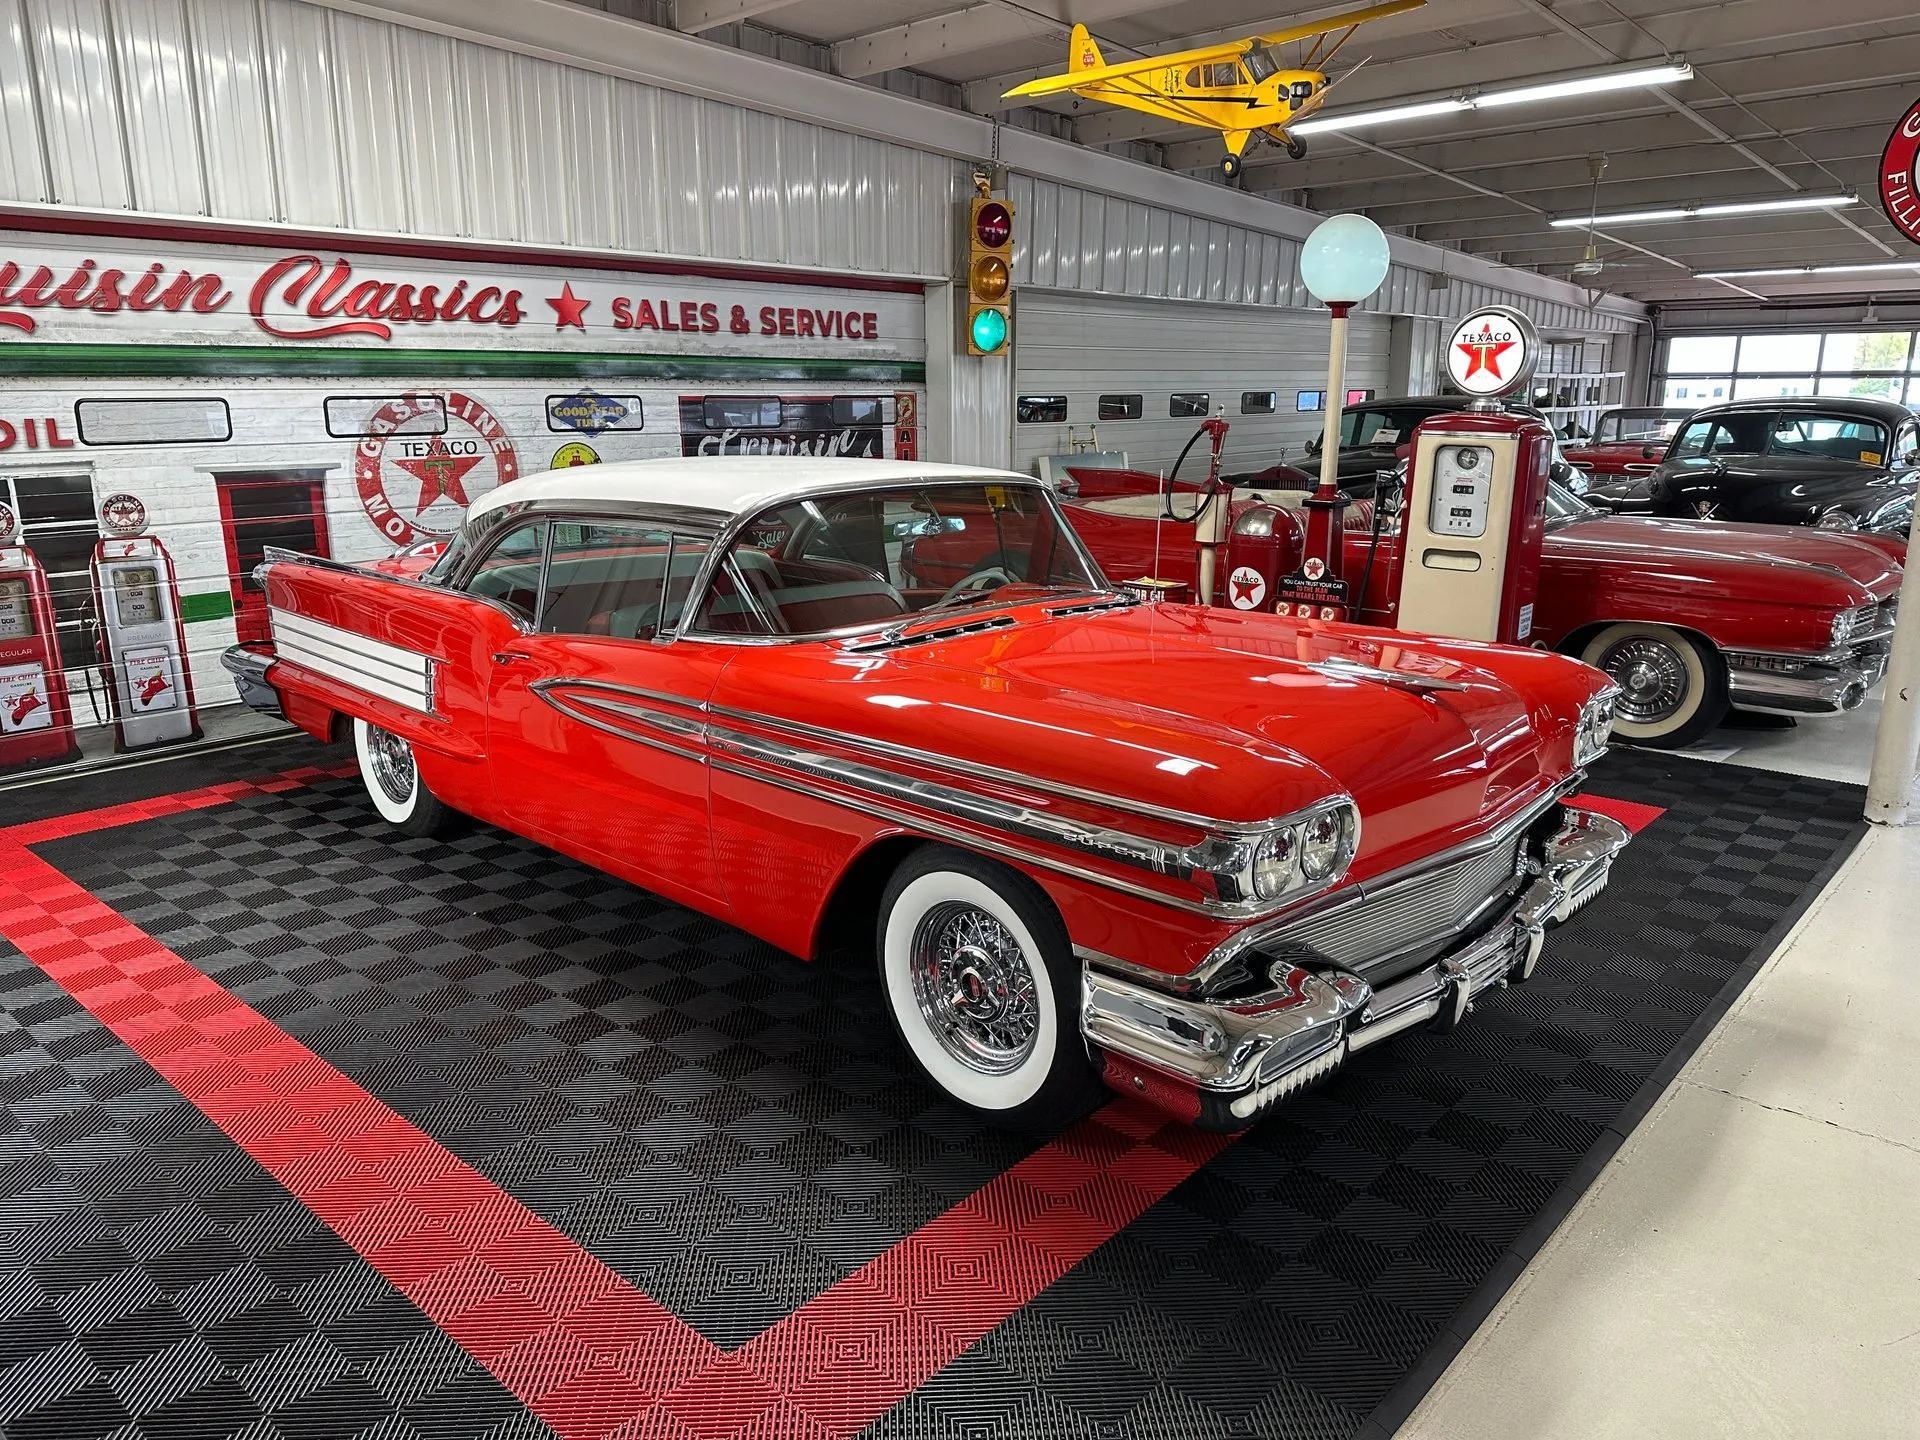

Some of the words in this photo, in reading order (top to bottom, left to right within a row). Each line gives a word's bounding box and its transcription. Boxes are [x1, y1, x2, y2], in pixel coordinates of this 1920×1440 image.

[249, 255, 528, 341] Classics
[612, 297, 720, 333] SALES
[730, 304, 751, 335] &
[759, 306, 879, 339] SERVICE
[1462, 332, 1512, 343] TEXACO
[360, 391, 513, 458] GASOLINE
[401, 440, 478, 458] TEXACO
[1233, 575, 1259, 584] TEXACO
[127, 633, 162, 642] PREMIUM
